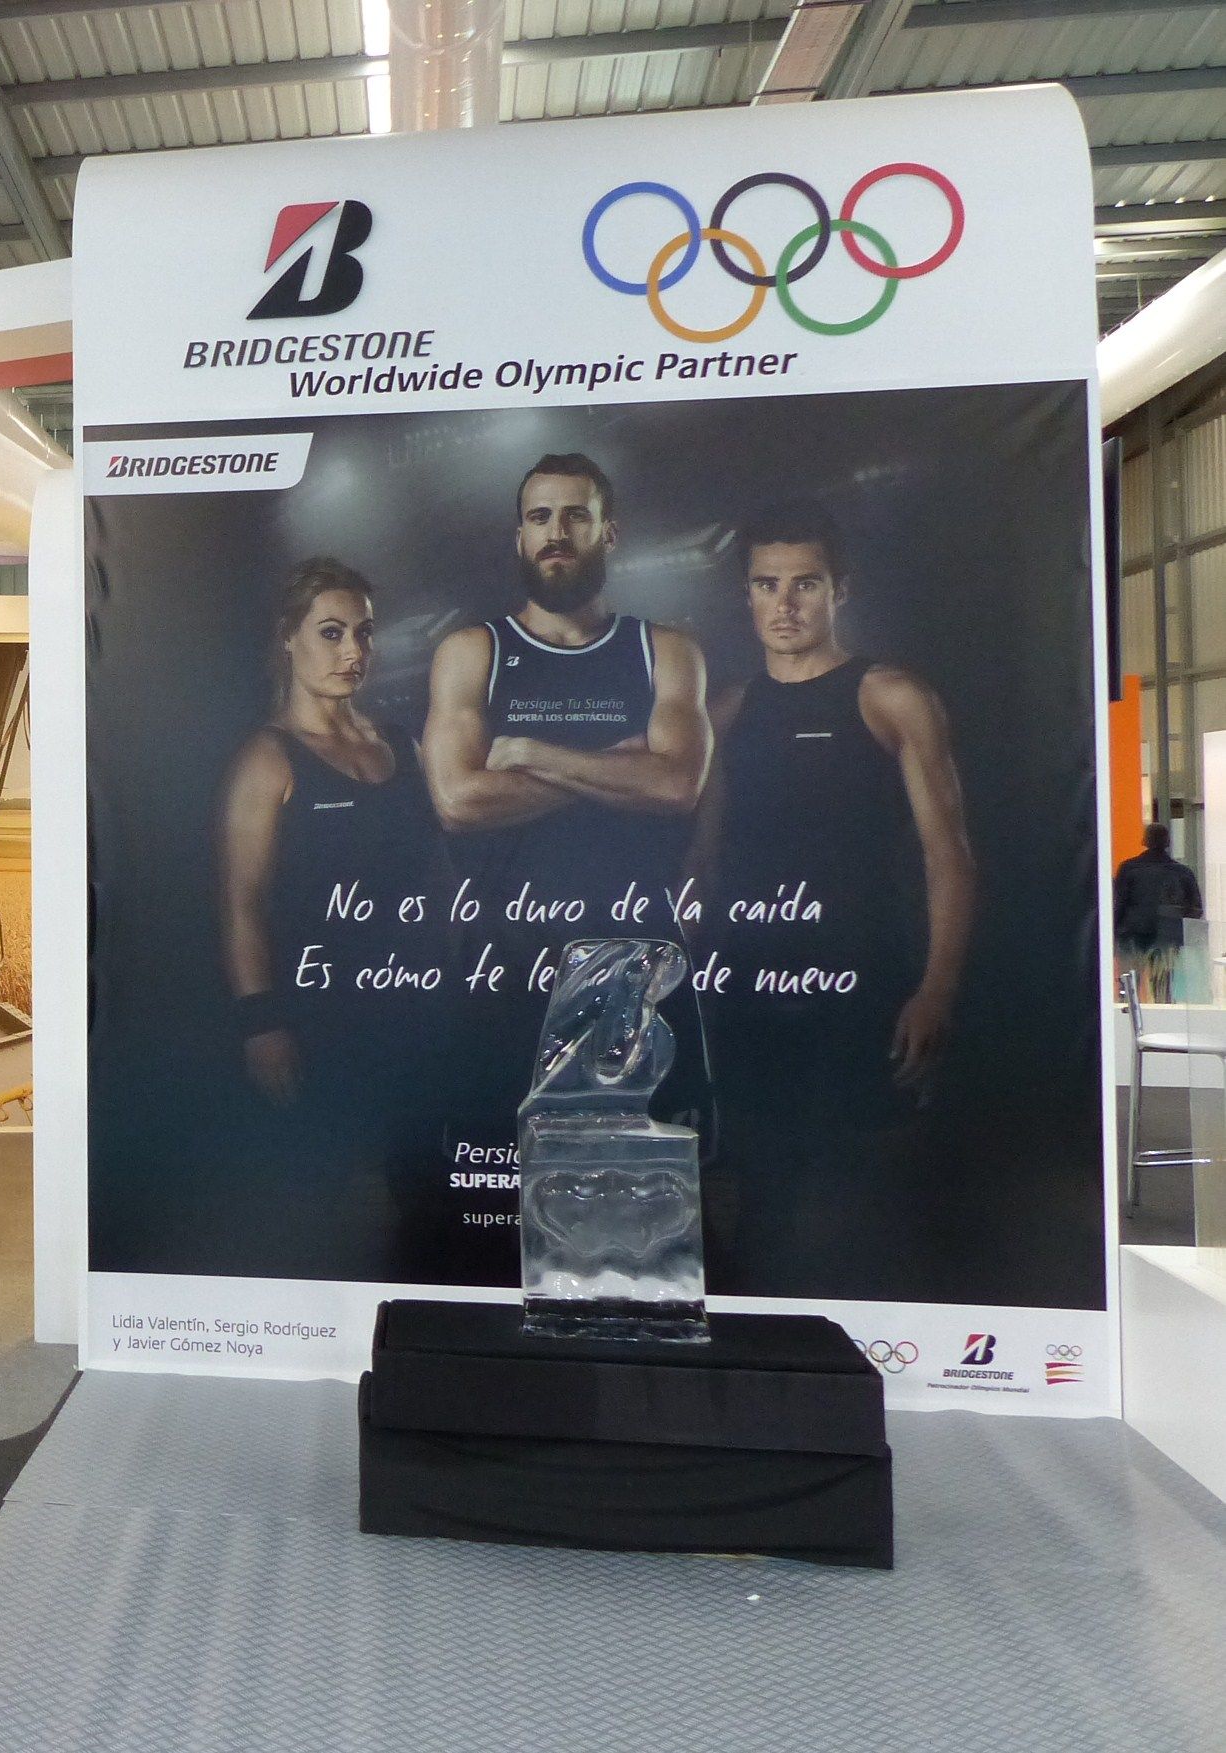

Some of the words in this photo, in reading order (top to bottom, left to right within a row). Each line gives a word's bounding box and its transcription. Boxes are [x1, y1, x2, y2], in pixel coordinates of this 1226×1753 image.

[184, 329, 435, 370] BRIDGESTONE
[288, 362, 484, 399] Worldwide
[494, 353, 646, 395] Olympic
[655, 347, 799, 384] Partner
[105, 451, 279, 480] BRIDGESTONE
[507, 713, 544, 722] SUPERA
[546, 714, 563, 722] LOS
[565, 712, 627, 723] OBSTÁCULOS
[509, 698, 563, 712] Persigue
[567, 699, 581, 710] Tu
[584, 697, 624, 711] Sueño
[326, 880, 374, 922] No
[397, 896, 427, 923] es
[449, 878, 480, 923] lo
[505, 881, 585, 923] duro
[610, 881, 650, 923] de
[673, 878, 702, 924] la
[729, 881, 823, 923] caída
[295, 945, 332, 990] Es
[355, 952, 442, 990] cómo
[464, 942, 504, 993] te
[691, 951, 732, 994] de
[755, 970, 858, 995] nuevo
[112, 1314, 143, 1330] Lidia
[148, 1316, 209, 1333] Valentín,
[214, 1319, 259, 1338] Sergio
[263, 1320, 337, 1340] Rodríguez
[112, 1337, 121, 1351] y
[127, 1336, 166, 1351] Javier
[170, 1336, 222, 1353] Gómez
[226, 1340, 264, 1356] Noya
[943, 1369, 1014, 1380] BRIDGESTONE
